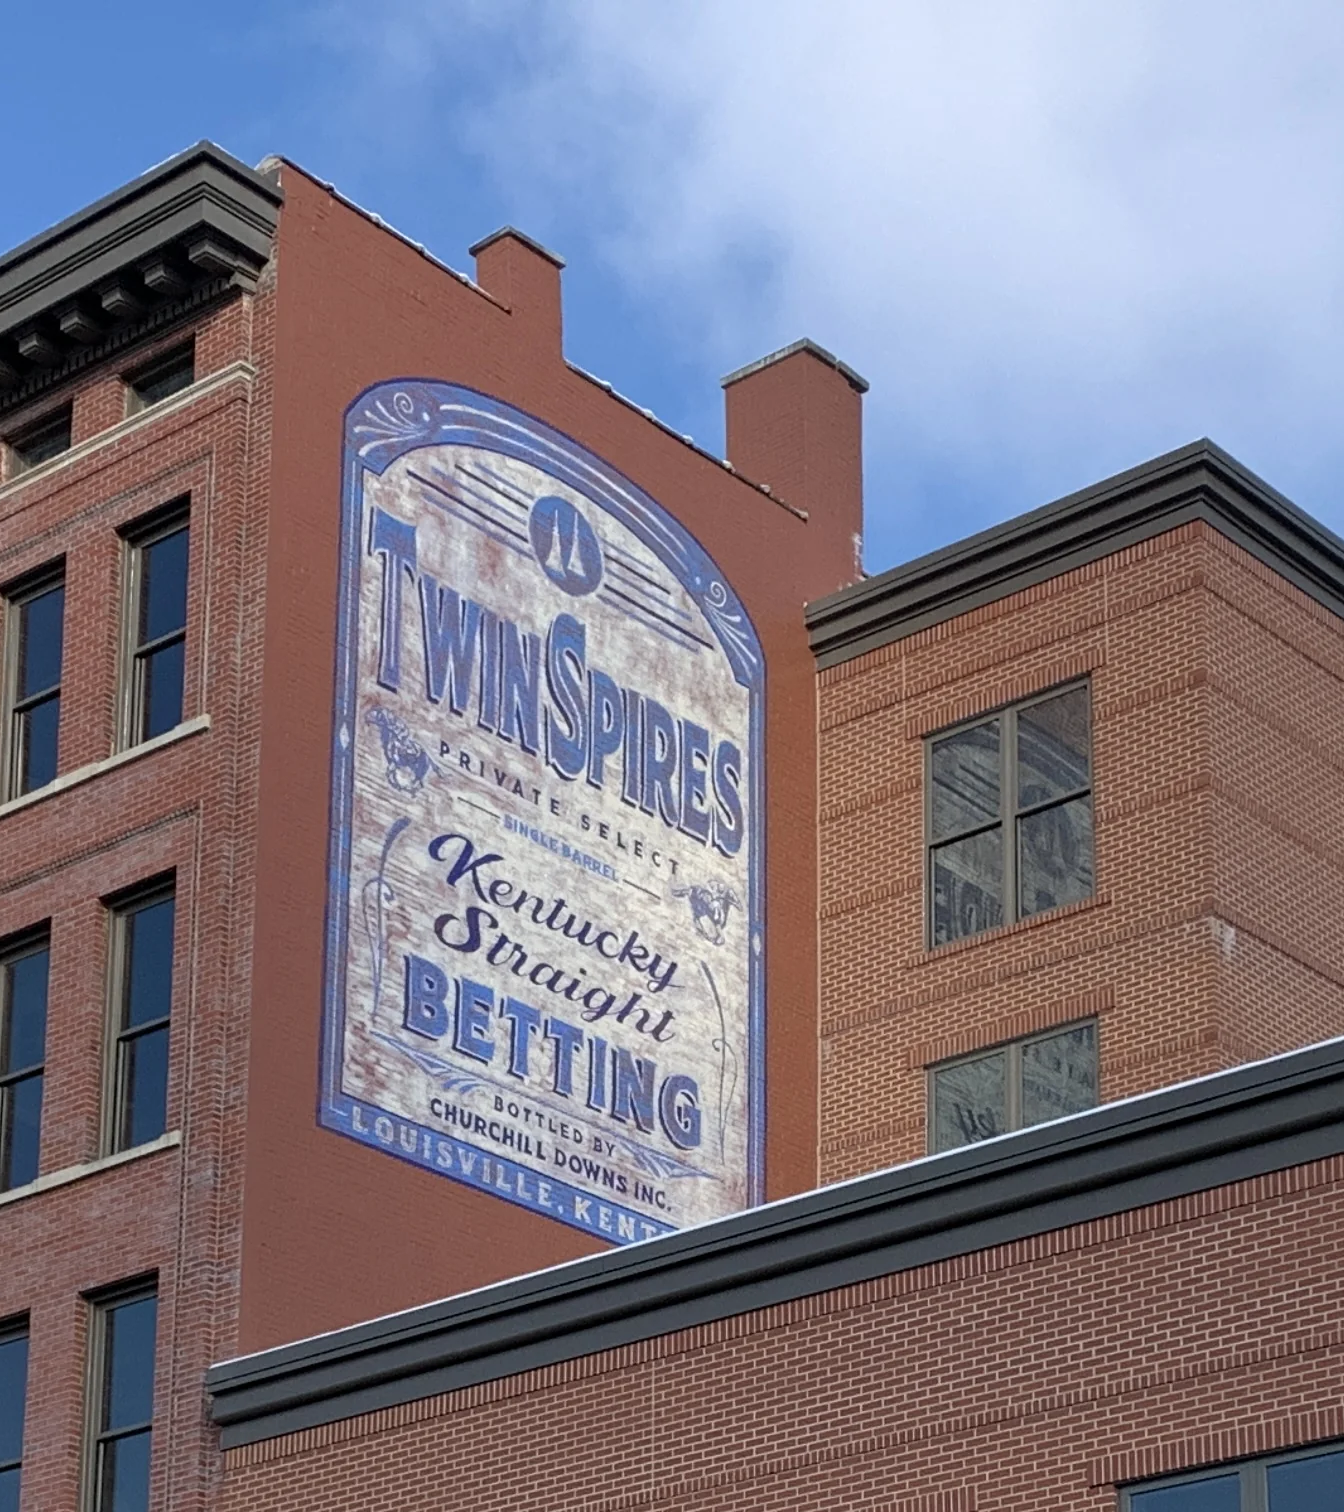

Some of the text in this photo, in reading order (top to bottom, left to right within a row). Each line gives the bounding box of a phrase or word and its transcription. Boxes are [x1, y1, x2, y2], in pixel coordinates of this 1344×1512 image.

[439, 740, 680, 875] PRIVATE SELECT
[503, 813, 619, 883] SINGLE BARREL
[427, 832, 685, 995] Kentucky
[433, 905, 677, 1044] Straight
[402, 953, 703, 1152] BETTING
[352, 1105, 670, 1242] LOUISVILLE, KENT
[430, 1098, 673, 1212] CHURCHILL DOWNS INC.
[493, 1095, 616, 1158] BOTTLED BY
